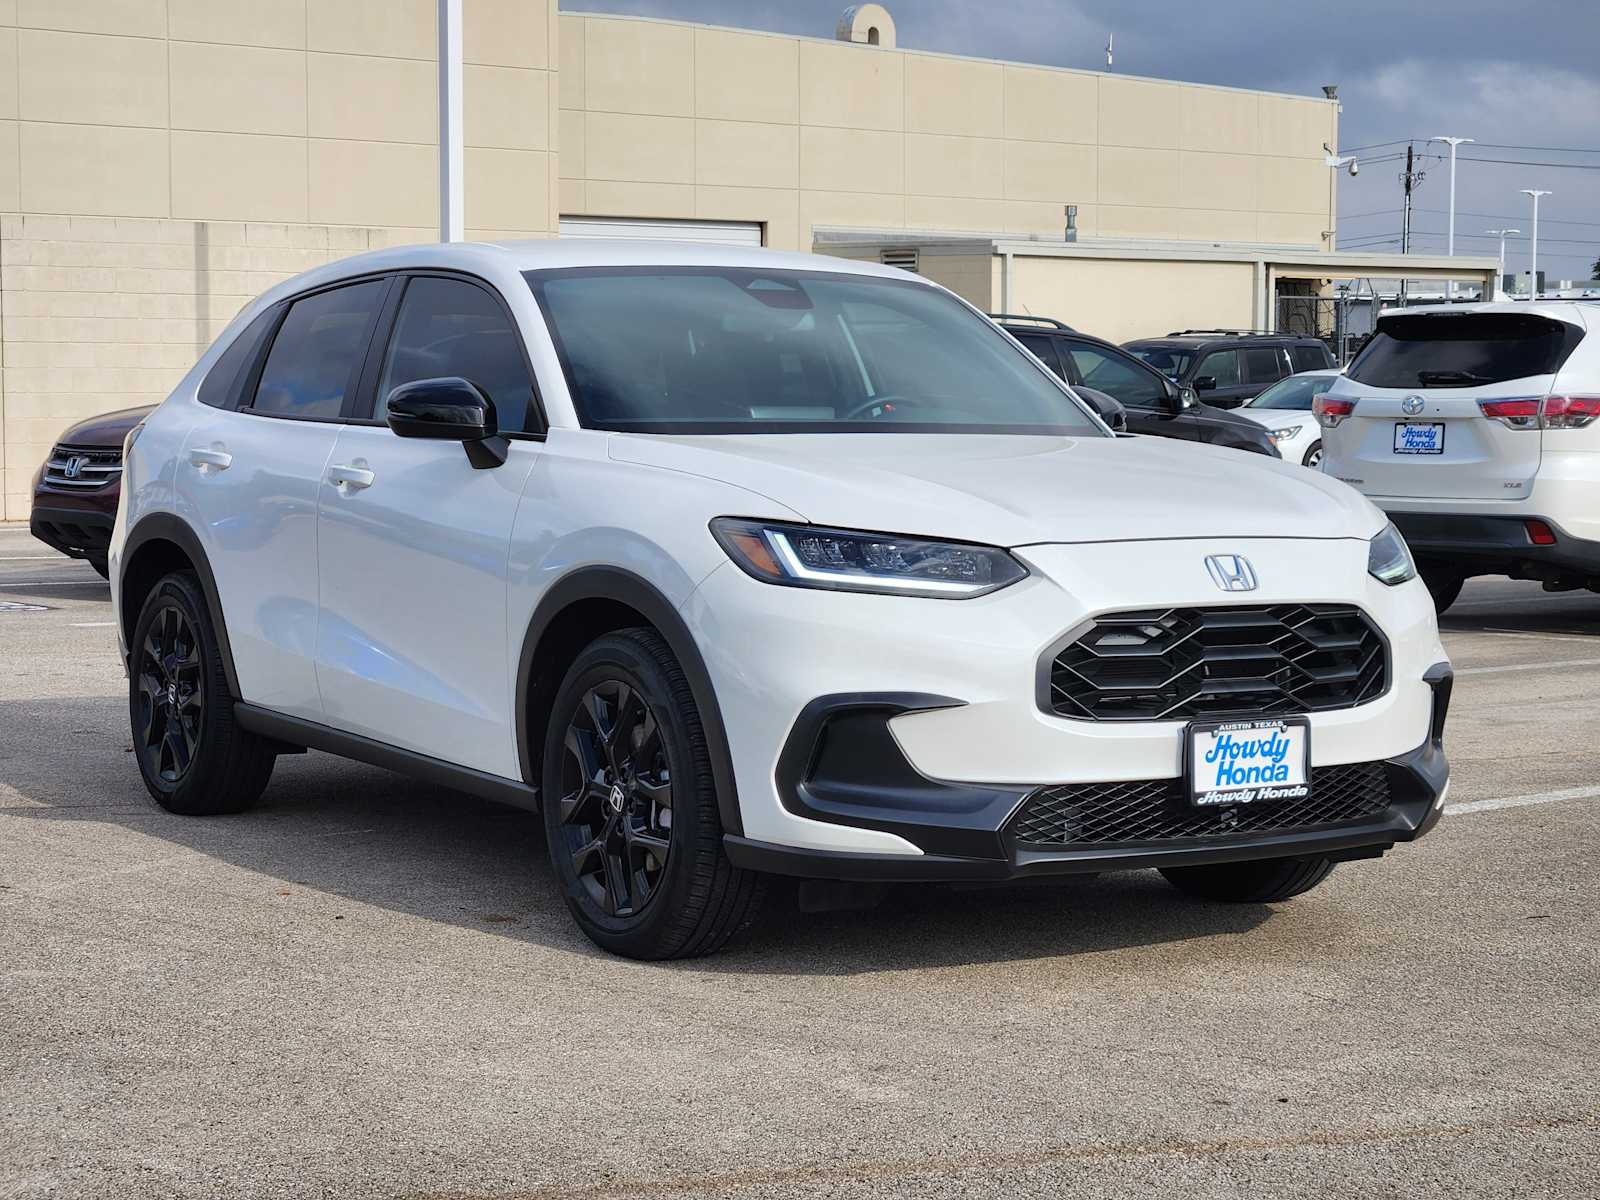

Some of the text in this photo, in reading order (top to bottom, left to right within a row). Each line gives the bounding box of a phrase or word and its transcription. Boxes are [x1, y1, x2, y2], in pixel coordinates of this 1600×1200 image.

[1401, 427, 1437, 440] Howdy
[1405, 438, 1436, 448] Honda
[1219, 720, 1285, 731] AUSTIN TEXAS
[1205, 731, 1290, 763] Howdy
[1215, 760, 1289, 786] Honda
[1197, 785, 1308, 803] Howdy Honda
